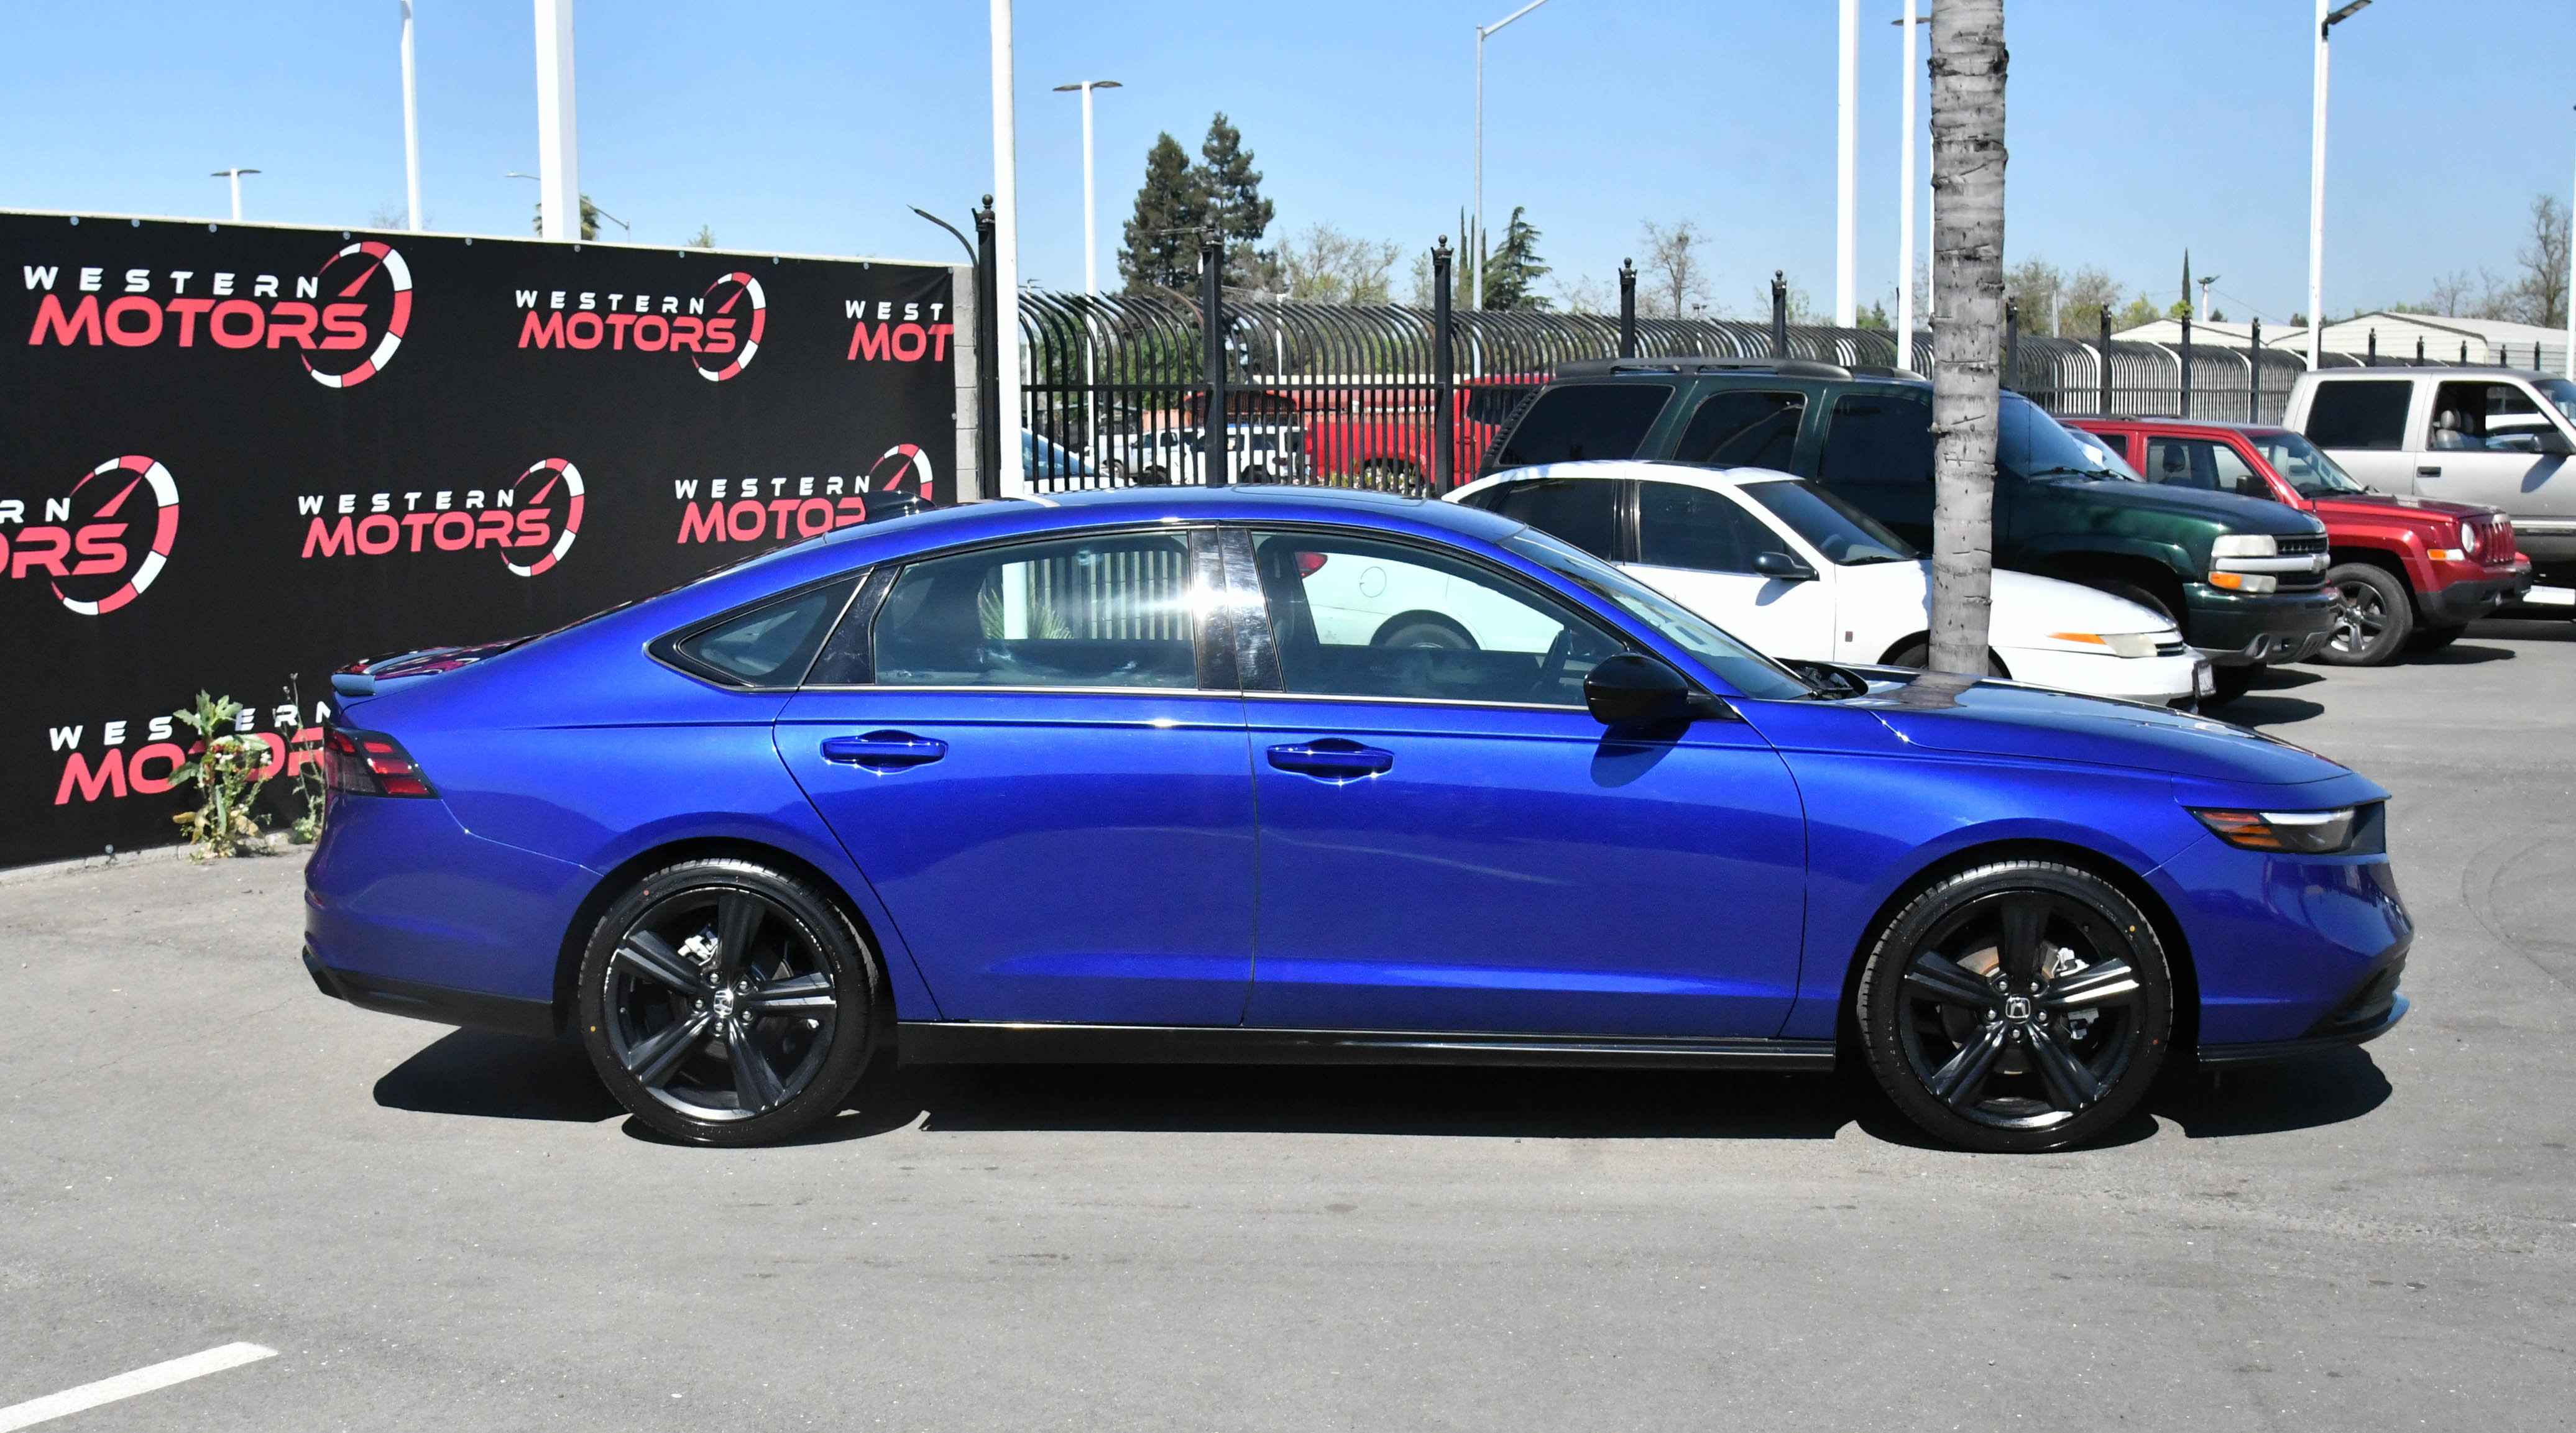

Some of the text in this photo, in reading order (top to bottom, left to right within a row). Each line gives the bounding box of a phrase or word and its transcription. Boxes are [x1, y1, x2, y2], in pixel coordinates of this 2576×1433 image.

[24, 265, 318, 298] WESTERN
[29, 294, 368, 349] MOTORS
[515, 290, 704, 315] WESTERN
[845, 300, 944, 321] WEST
[518, 311, 736, 353] MOTORS
[847, 321, 954, 362] MOT
[298, 489, 514, 515] WESTERN
[674, 475, 870, 500] WESTERN
[0, 523, 129, 579] RS
[301, 508, 551, 558] MOTORS
[49, 701, 331, 751] WESERN
